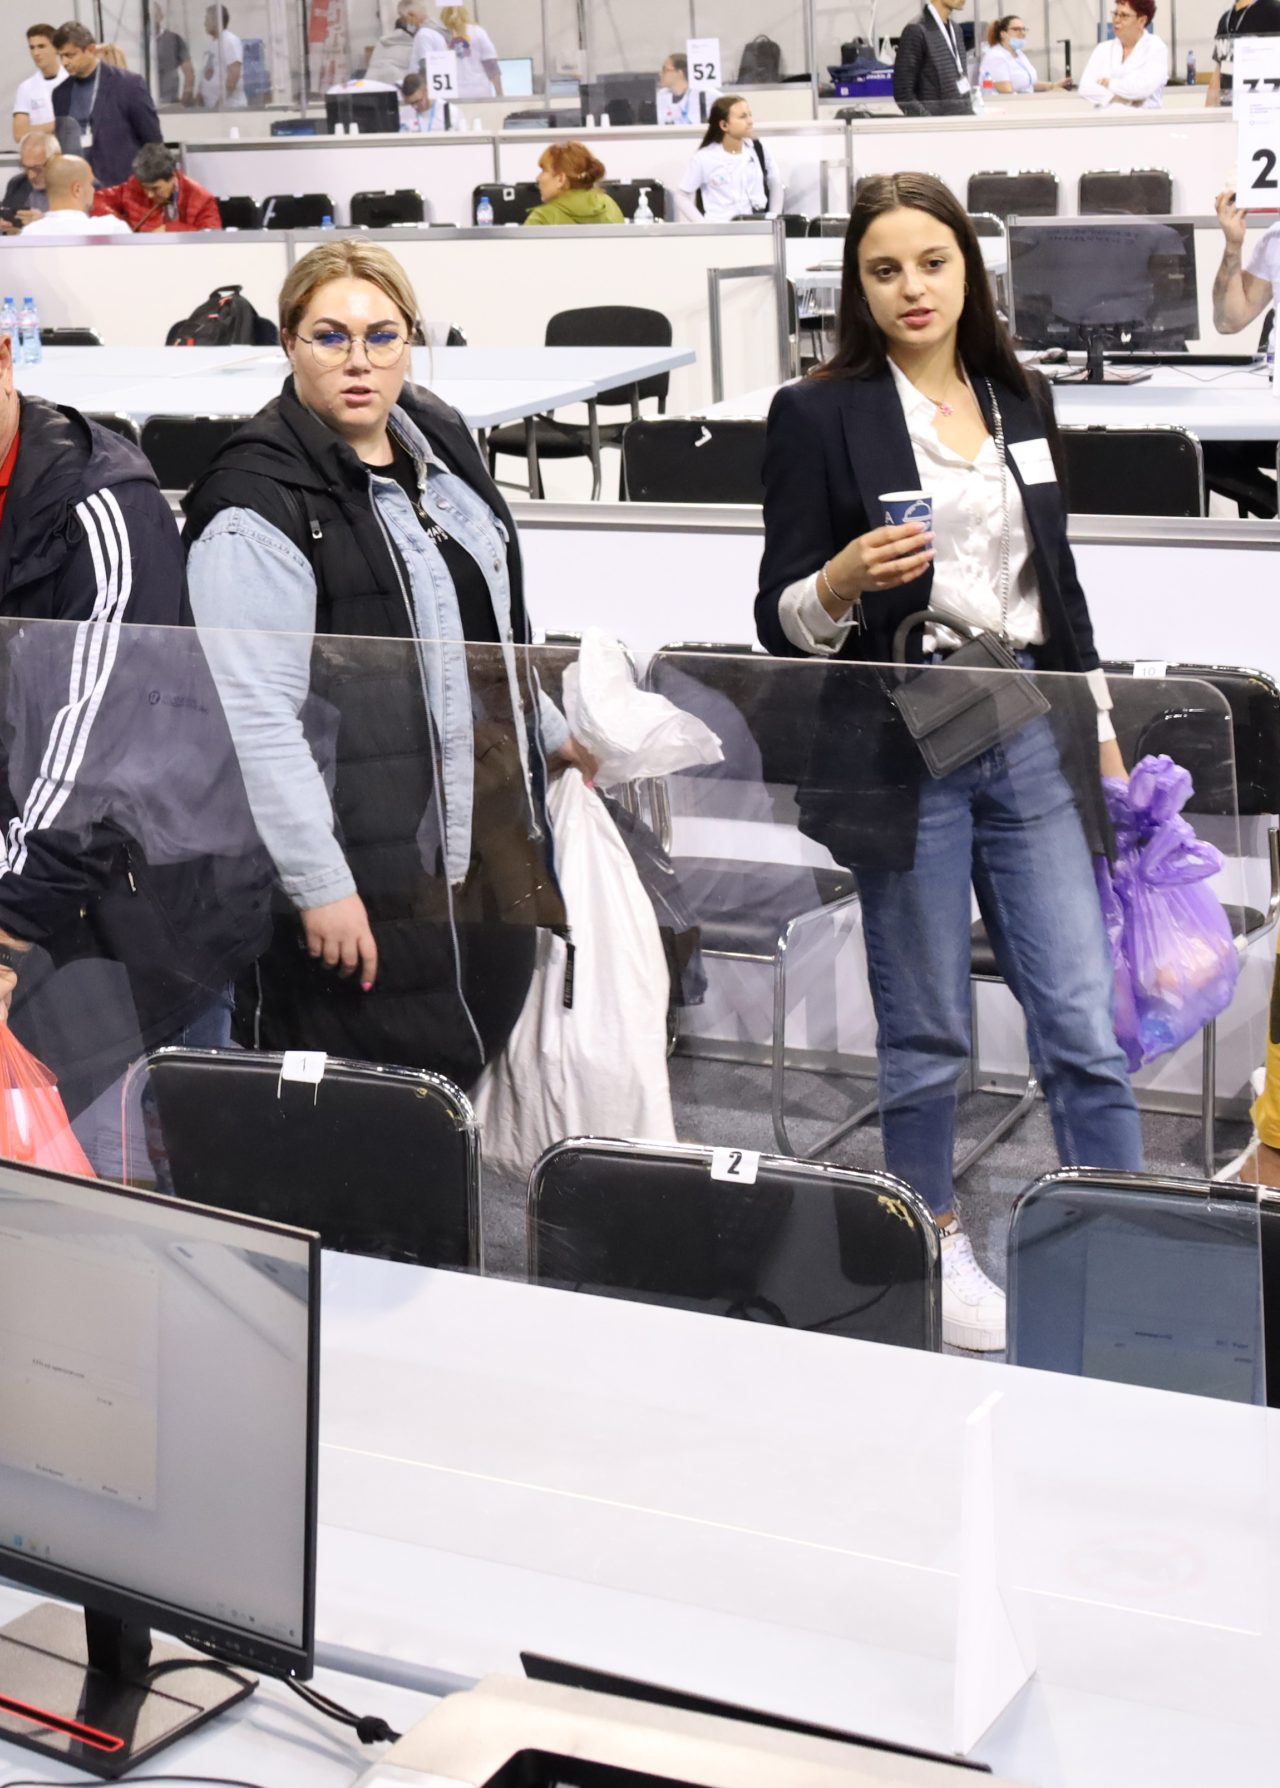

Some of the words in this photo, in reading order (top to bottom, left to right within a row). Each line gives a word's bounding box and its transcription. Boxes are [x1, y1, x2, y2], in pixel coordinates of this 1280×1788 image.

[694, 63, 716, 80] 52
[433, 74, 453, 91] 51
[1142, 666, 1157, 677] 10
[727, 1151, 743, 1175] 2
